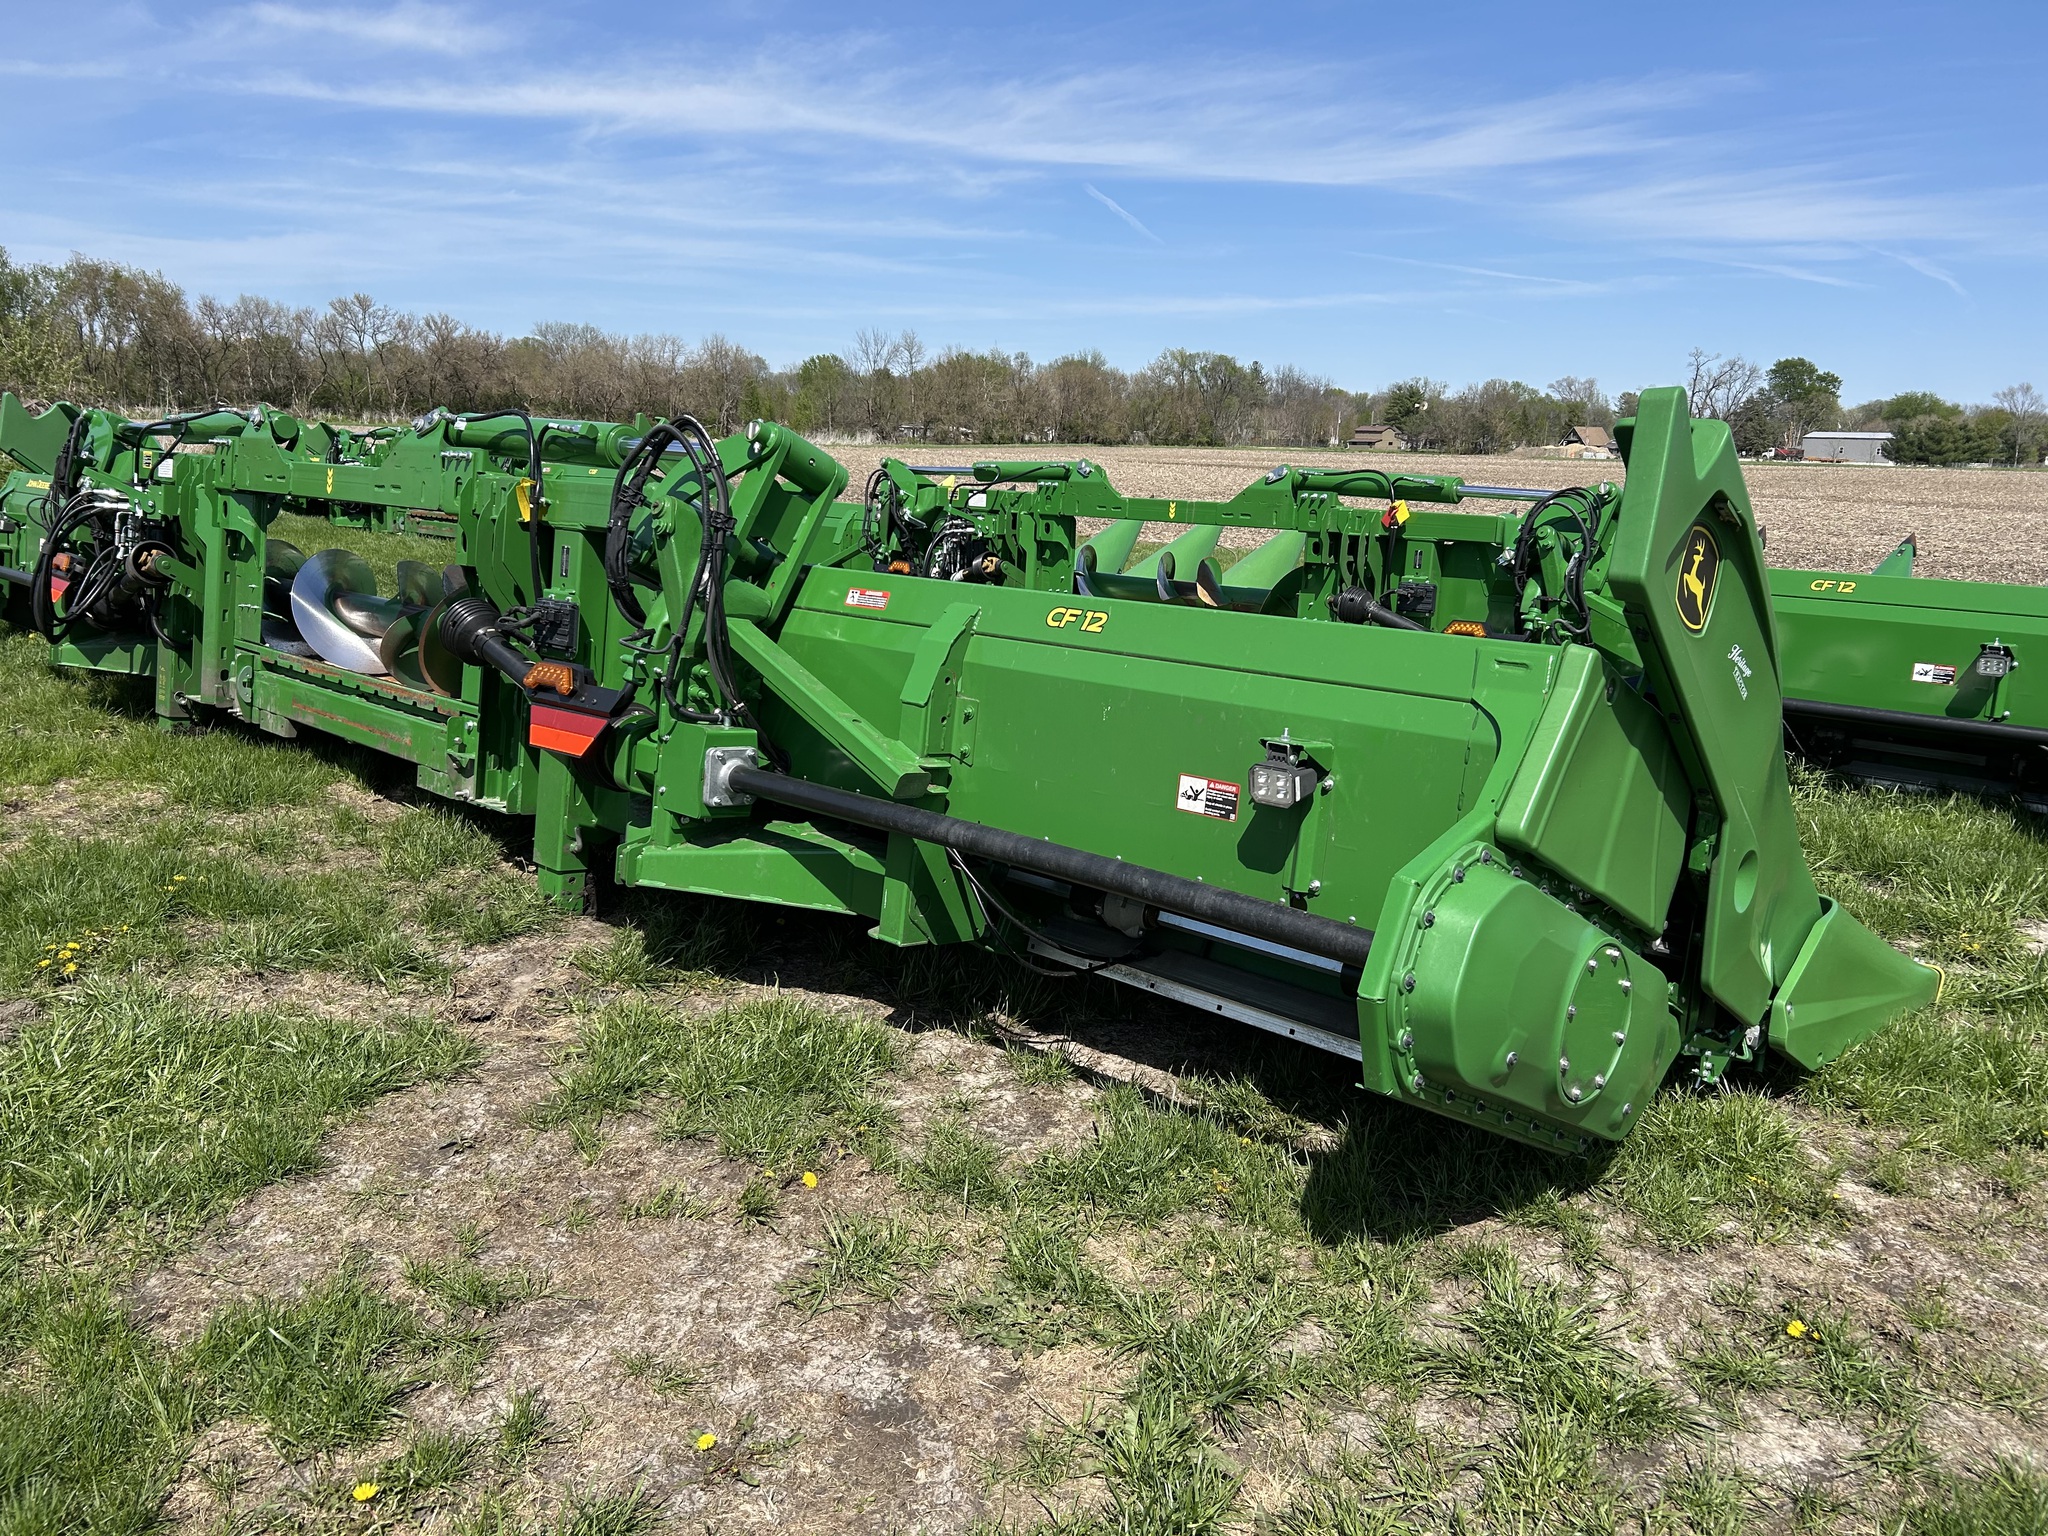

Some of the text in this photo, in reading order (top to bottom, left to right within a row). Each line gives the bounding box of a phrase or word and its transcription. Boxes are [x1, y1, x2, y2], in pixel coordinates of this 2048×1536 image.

[1810, 579, 1857, 594] CF 12
[1046, 606, 1109, 634] CF 12
[1728, 644, 1752, 677] Heritage
[1215, 783, 1236, 792] DANGER
